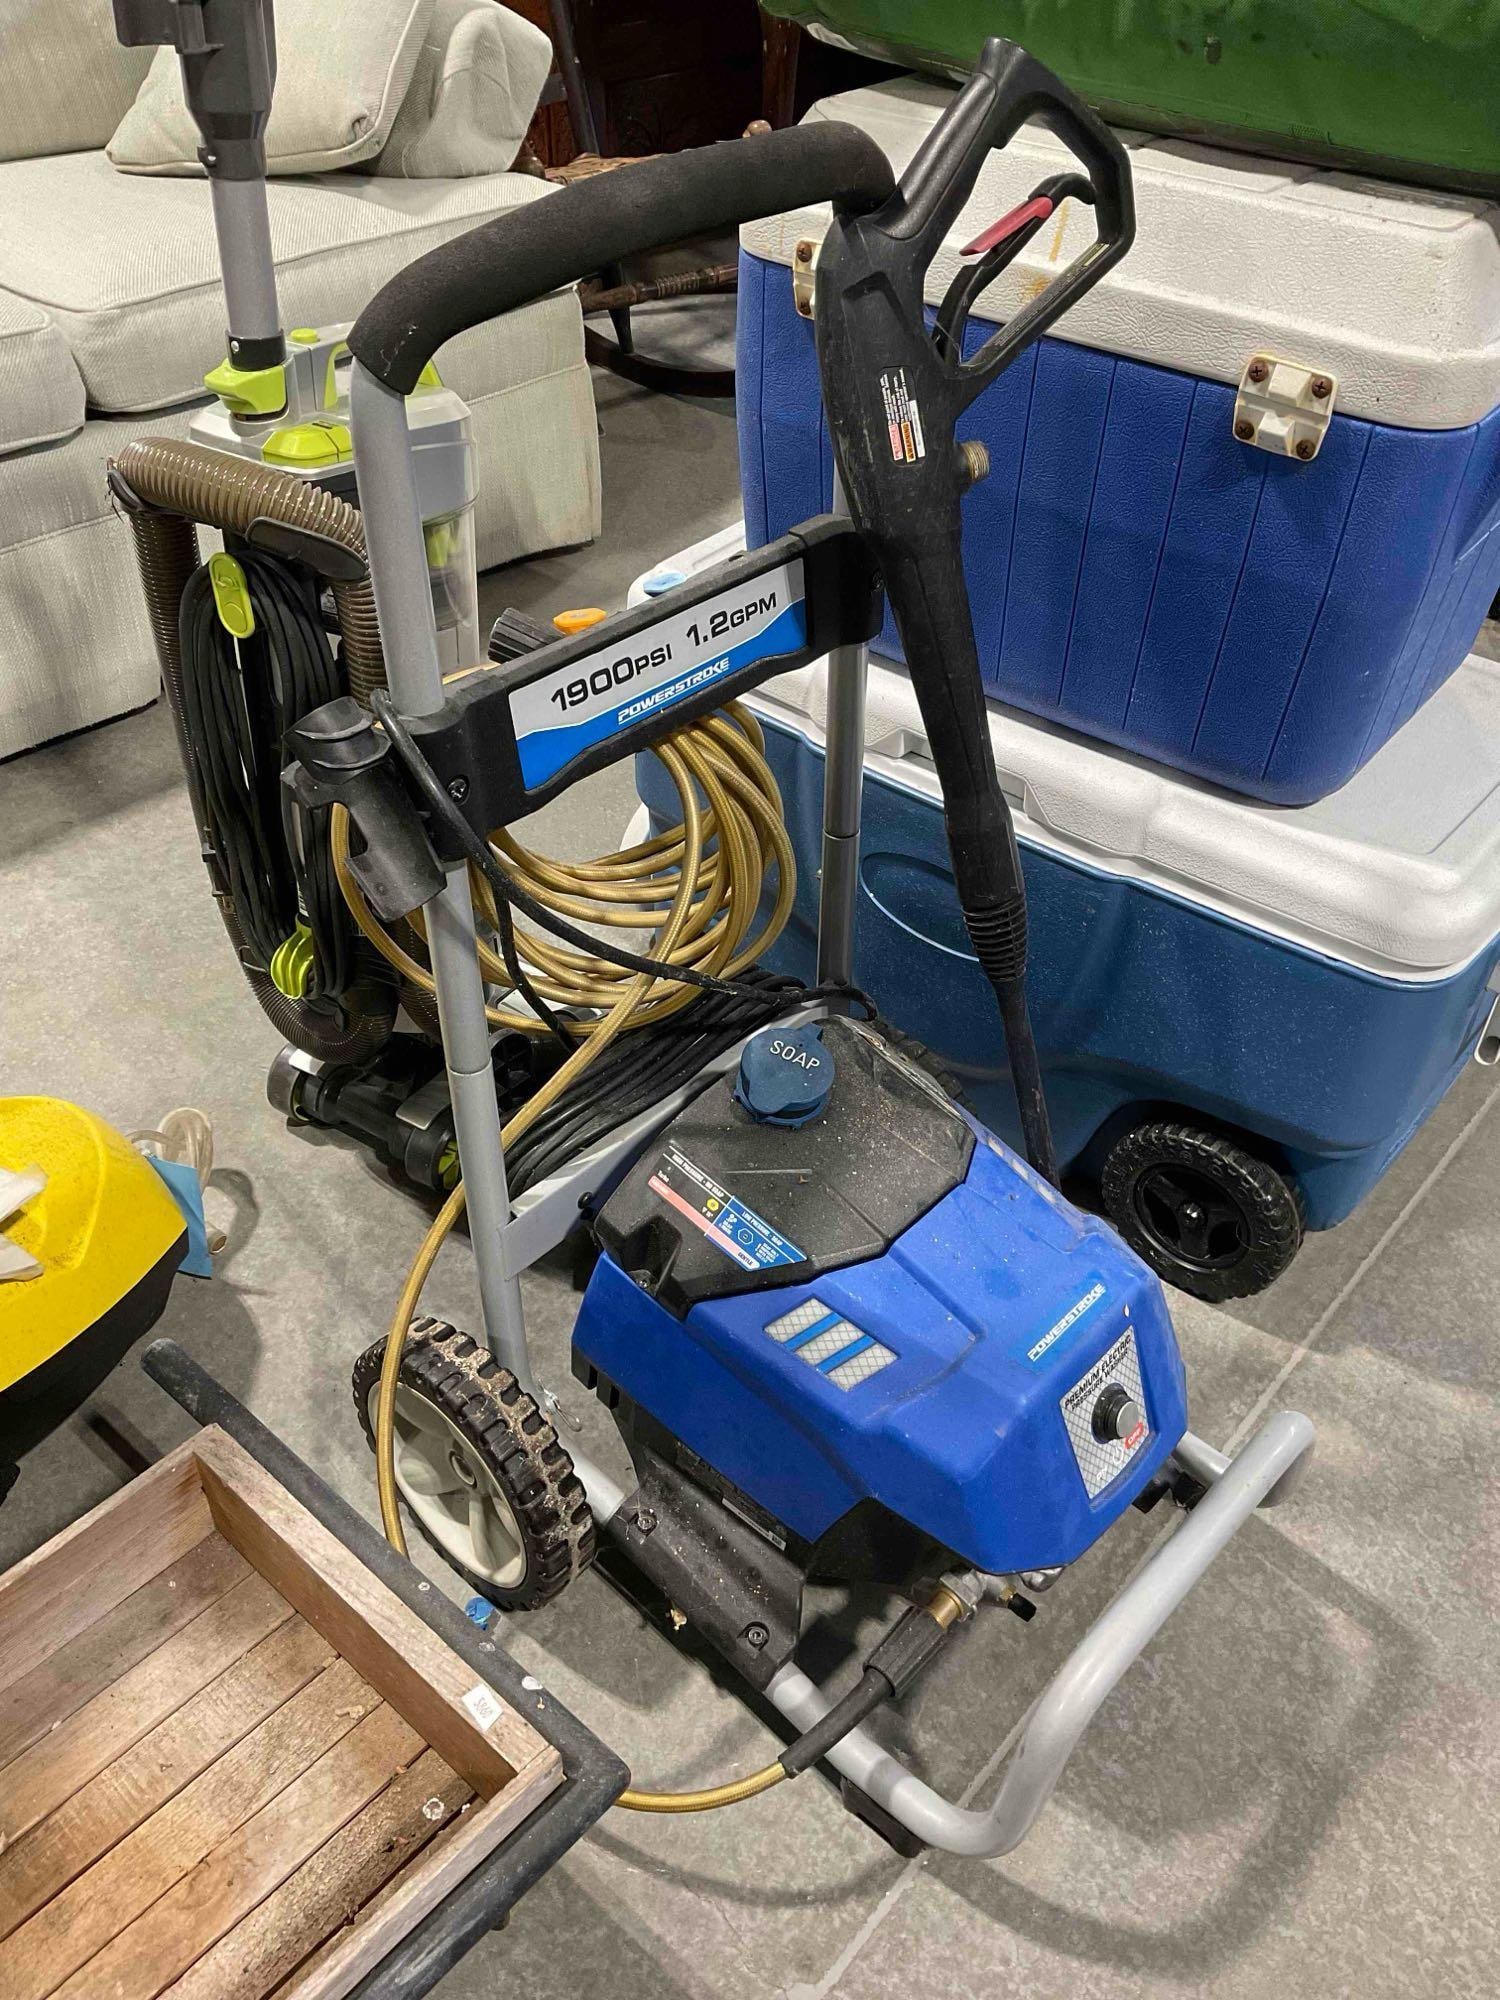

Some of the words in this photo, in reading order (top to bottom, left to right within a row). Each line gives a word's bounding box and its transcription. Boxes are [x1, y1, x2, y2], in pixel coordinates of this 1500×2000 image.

[551, 644, 672, 711] 1900PSI
[686, 592, 777, 647] 1.2GPM
[617, 657, 729, 725] POWERSTROKE
[770, 1040, 820, 1070] SOAP
[738, 1252, 753, 1266] GENTLE
[1027, 1283, 1106, 1362] POWERSTROKE
[1065, 1369, 1100, 1409] PREMIUM
[1101, 1334, 1131, 1373] ELECTRIC
[1071, 1379, 1104, 1411] PRESSURE
[1104, 1347, 1128, 1378] WASHER
[1127, 1426, 1143, 1446] OFF
